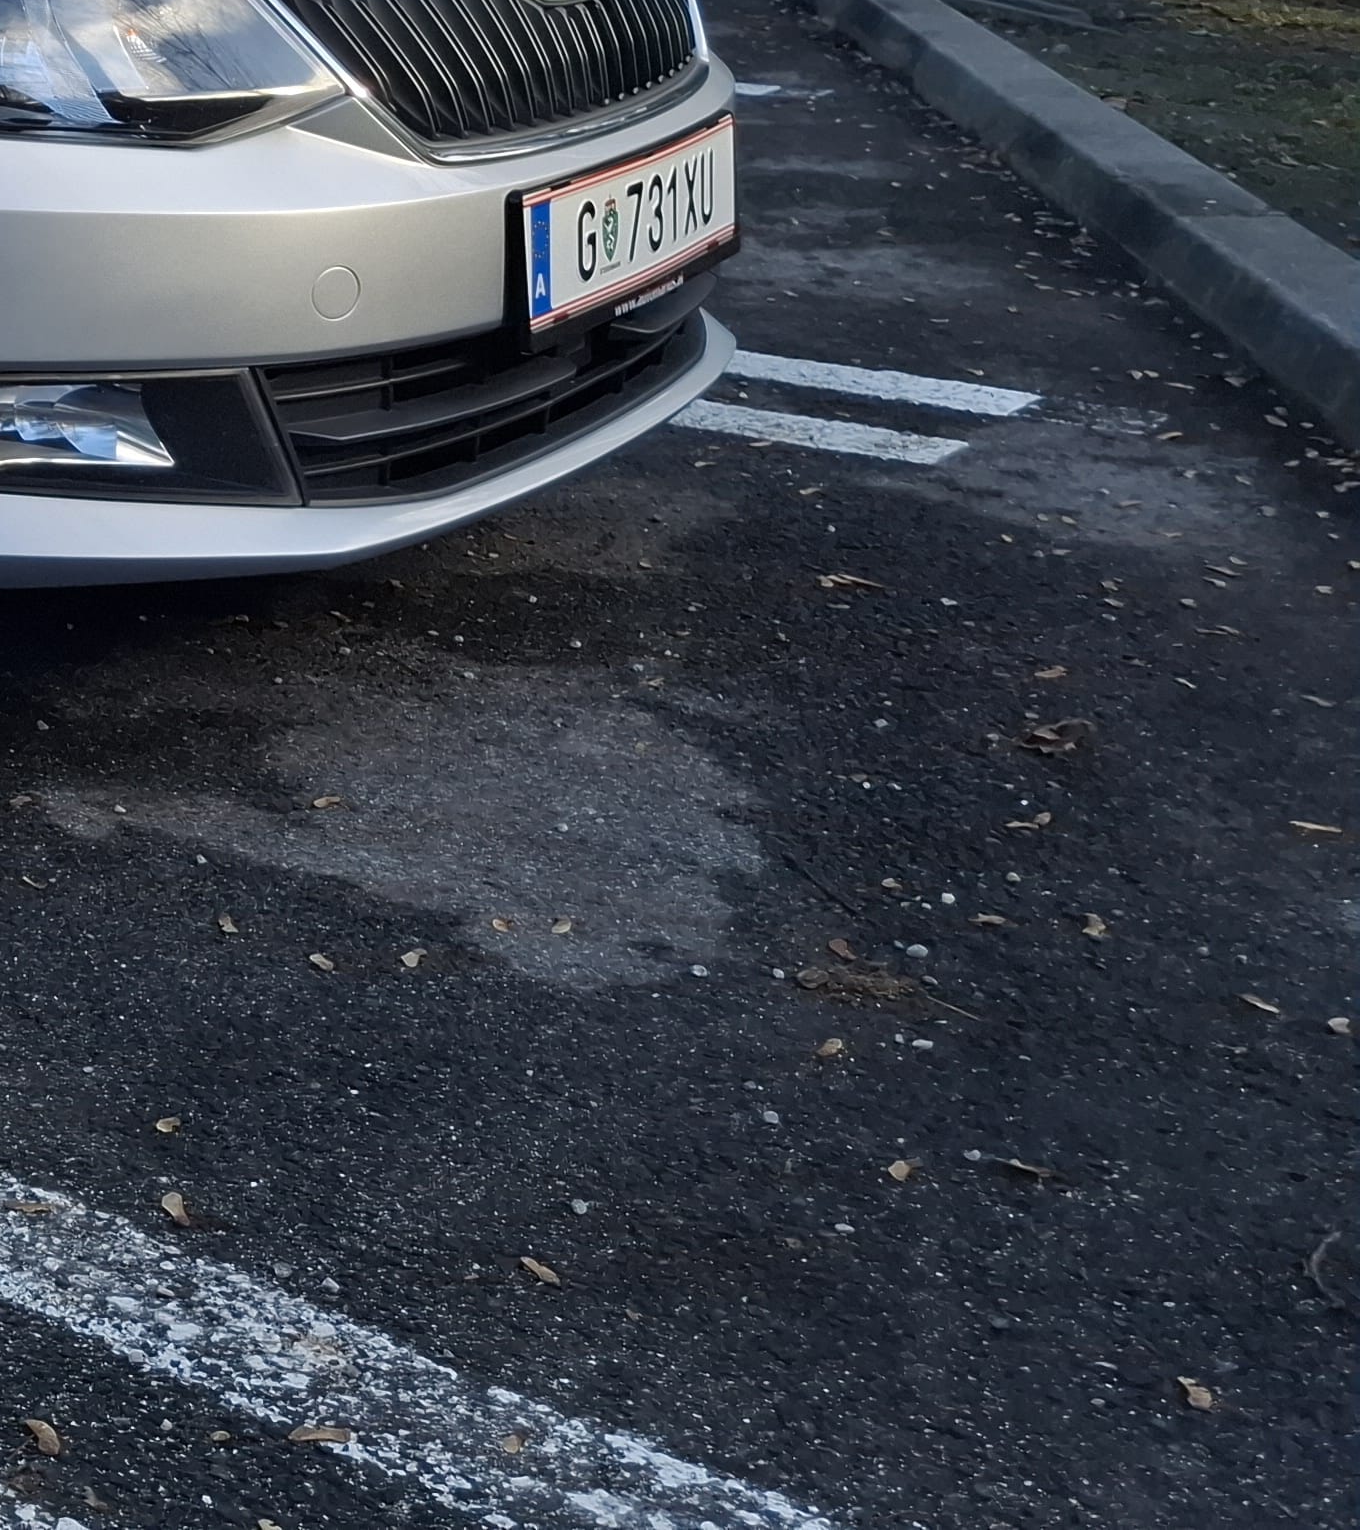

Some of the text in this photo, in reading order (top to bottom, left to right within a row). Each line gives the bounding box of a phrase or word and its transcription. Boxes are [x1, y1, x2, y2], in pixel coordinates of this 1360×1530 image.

[577, 147, 714, 282] G 731XU
[535, 273, 546, 299] A
